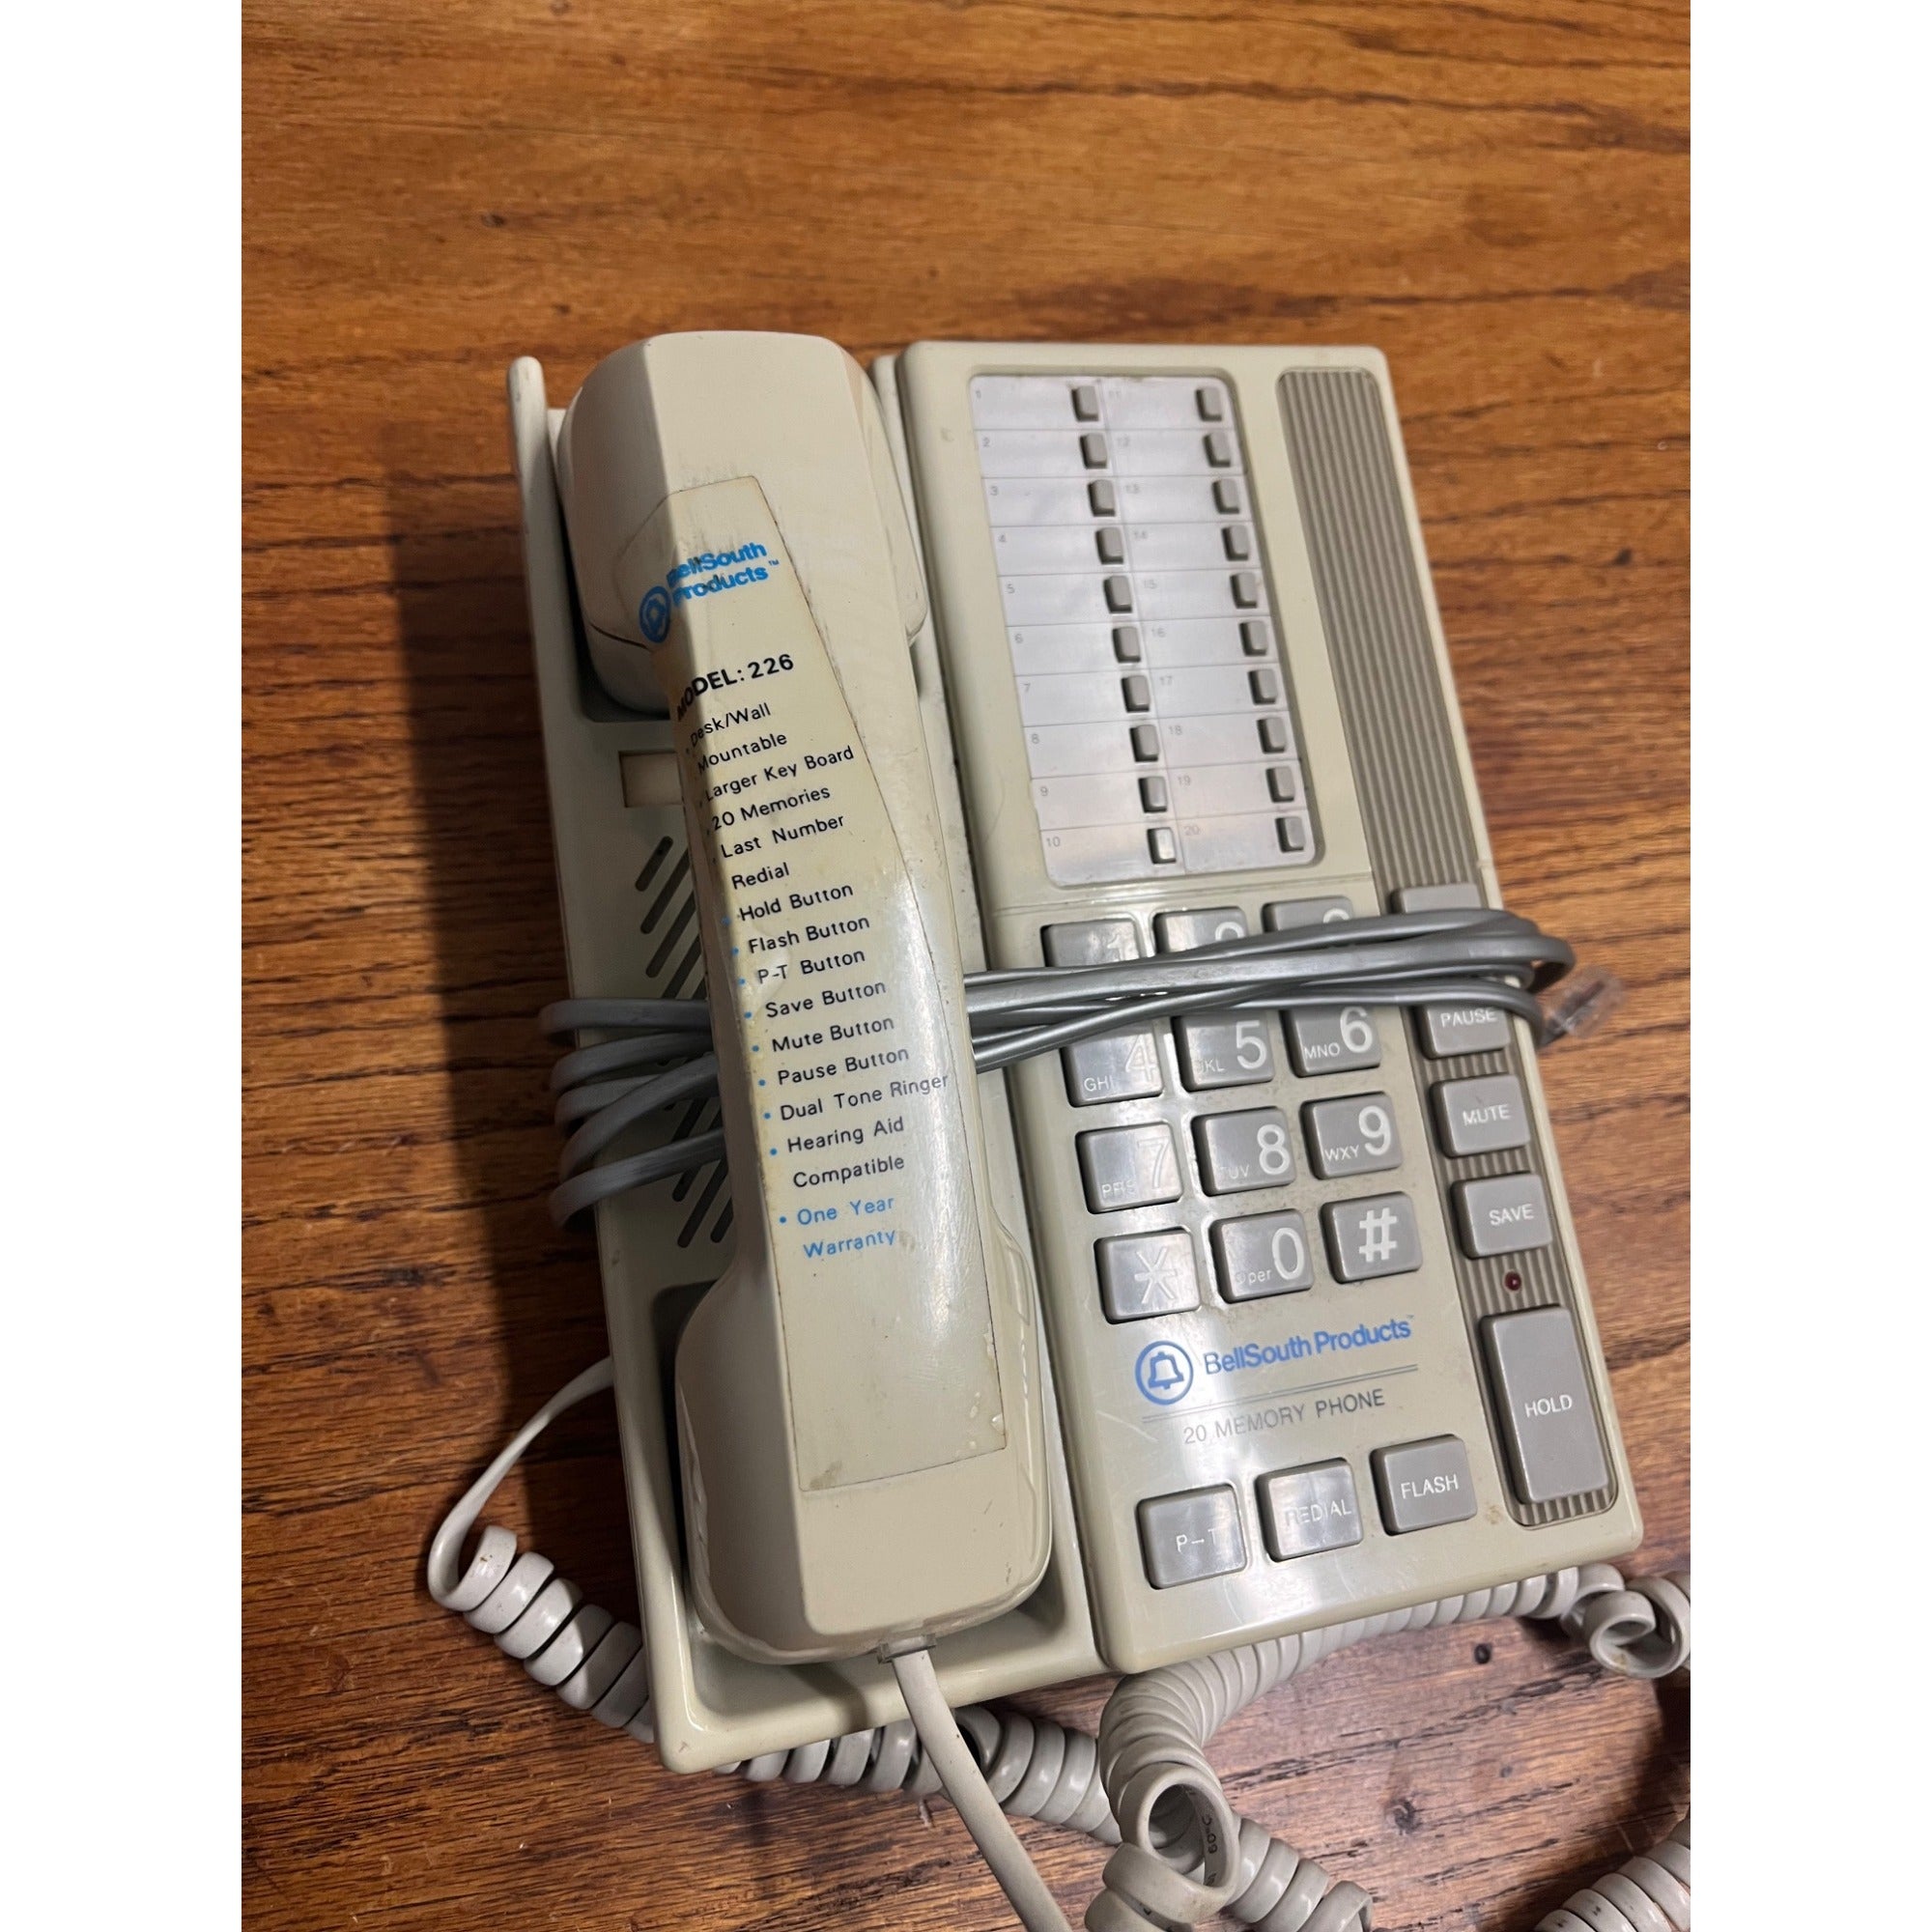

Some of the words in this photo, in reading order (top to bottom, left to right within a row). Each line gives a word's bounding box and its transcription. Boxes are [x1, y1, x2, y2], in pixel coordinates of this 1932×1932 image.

[667, 542, 767, 587] BellSouth
[672, 567, 769, 607] Products
[677, 669, 745, 722] MODEL:
[748, 654, 794, 679] 226
[1159, 676, 1173, 685] 17
[690, 702, 771, 747] Desk/Wall
[1032, 734, 1039, 744] 8
[1169, 725, 1182, 735] 18
[697, 734, 787, 773] Mountable
[705, 775, 757, 801] Larger
[764, 763, 797, 781] Key
[804, 746, 854, 770] Board
[1178, 776, 1191, 785] 19
[712, 811, 735, 831] 20
[740, 786, 831, 820] Memories
[1040, 786, 1048, 797] 9
[721, 837, 762, 858] Last
[772, 815, 844, 843] Number
[1046, 837, 1061, 847] 10
[1184, 826, 1200, 836] 20
[731, 862, 790, 890] Redial
[739, 898, 782, 921] Hold
[789, 884, 854, 909] Button
[749, 930, 800, 953] Flash
[806, 917, 870, 942] Button
[757, 964, 788, 984] P-T
[800, 950, 866, 975] Button
[765, 997, 813, 1018] Save
[822, 980, 886, 1006] Button
[772, 1032, 823, 1052] Mute
[830, 1016, 895, 1040] Button
[1339, 1006, 1373, 1053] 6
[1440, 1008, 1497, 1028] PAUSE
[1125, 1034, 1157, 1081] 4
[1236, 1020, 1267, 1070] 5
[1304, 1043, 1340, 1060] MNO
[778, 1064, 838, 1085] Pause
[844, 1048, 909, 1072] Button
[1084, 1075, 1114, 1092] GHI
[781, 1098, 823, 1121] Dual
[834, 1090, 883, 1109] Tone
[890, 1074, 949, 1097] Ringer
[1463, 1104, 1511, 1125] MUTE
[787, 1127, 864, 1152] Hearing
[873, 1117, 904, 1136] Aid
[1358, 1105, 1392, 1156] 9
[1137, 1136, 1170, 1189] 7
[1257, 1123, 1291, 1175] 8
[1323, 1145, 1360, 1162] WXY
[793, 1155, 905, 1188] Compatible
[1221, 1164, 1249, 1179] TUV
[797, 1208, 838, 1225] One
[850, 1197, 895, 1216] Year
[1489, 1203, 1534, 1226] SAVE
[804, 1230, 895, 1258] Warranty
[1272, 1227, 1304, 1280] 0
[1204, 1335, 1311, 1376] BellSouth
[1314, 1319, 1411, 1354] Products
[1183, 1424, 1207, 1444] 20
[1215, 1404, 1306, 1438] MEMORY
[1316, 1388, 1385, 1418] PHONE
[1524, 1394, 1573, 1417] HOLD
[1401, 1473, 1459, 1499] FLASH
[1285, 1498, 1351, 1527] REDIAL
[1177, 1528, 1219, 1552] P-T
